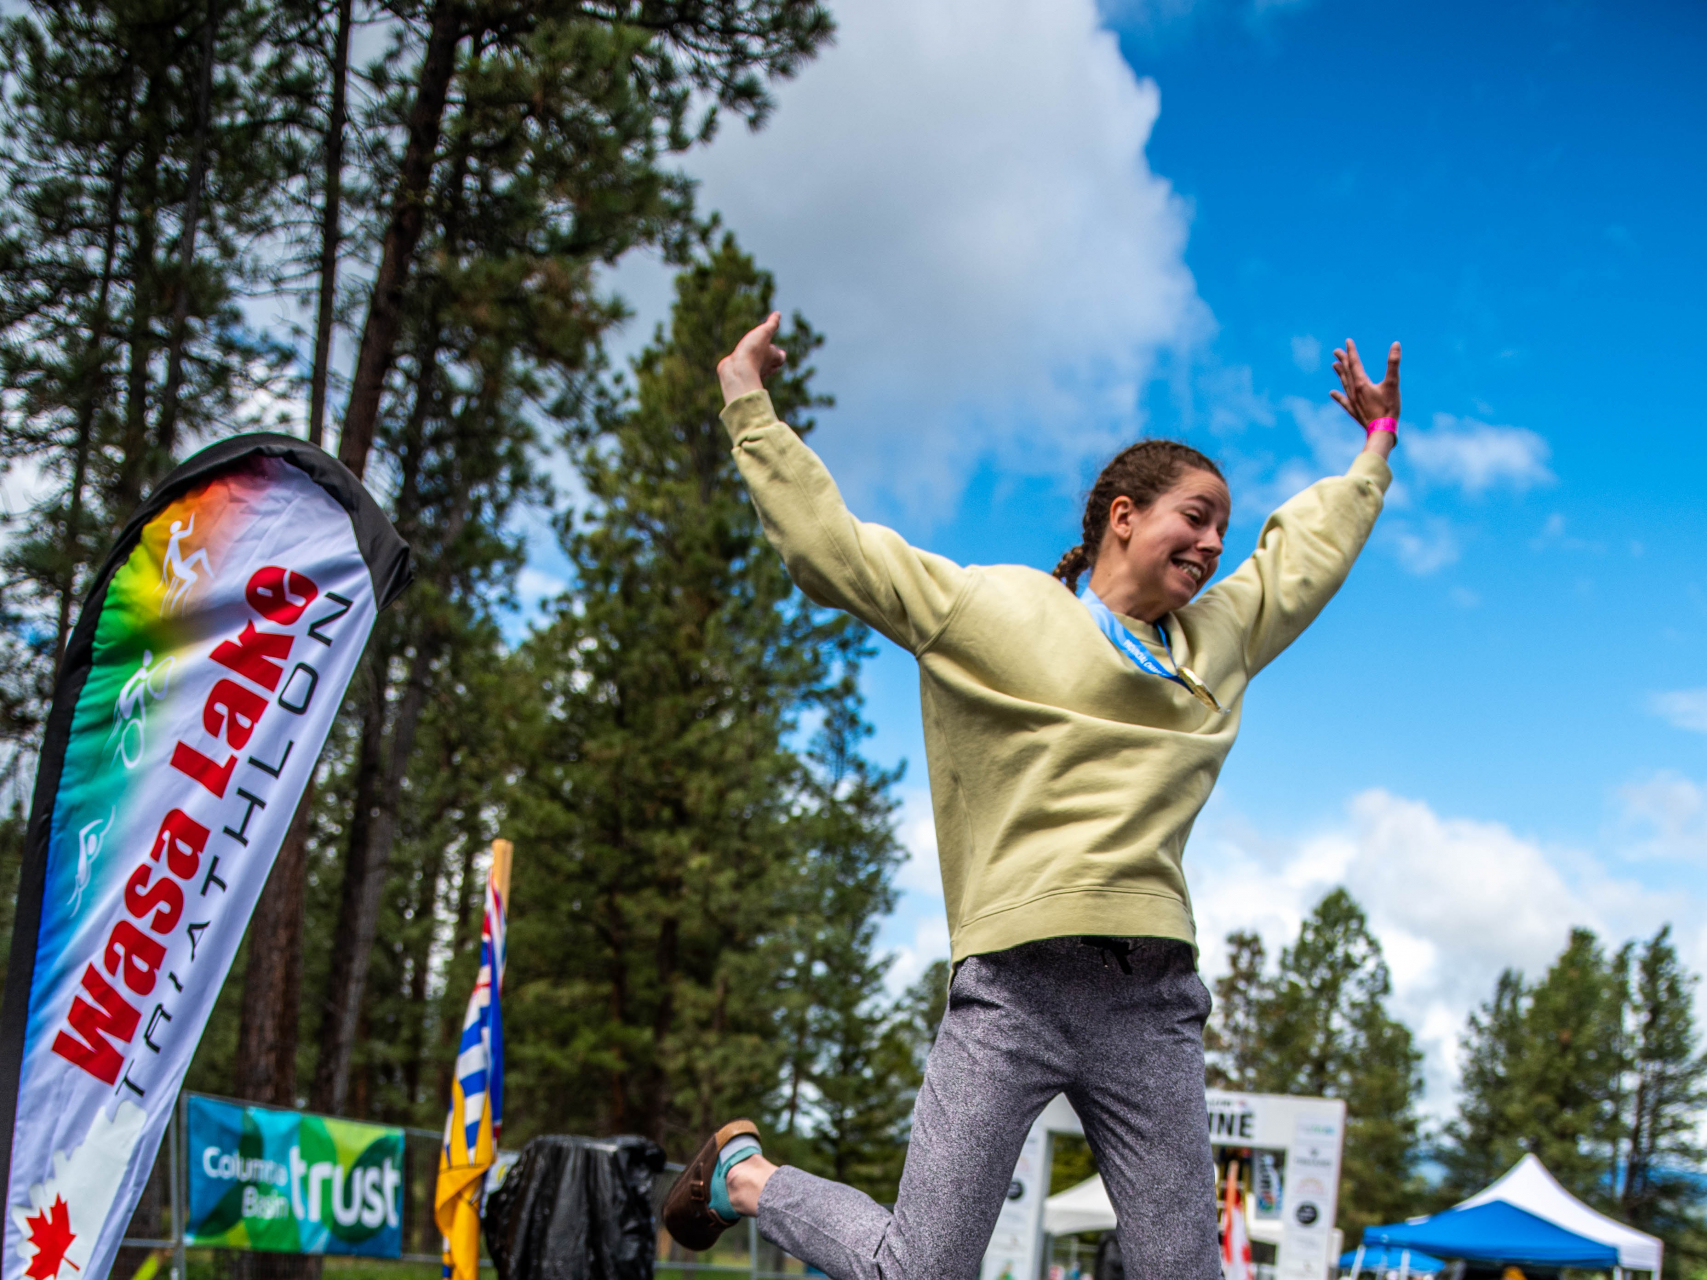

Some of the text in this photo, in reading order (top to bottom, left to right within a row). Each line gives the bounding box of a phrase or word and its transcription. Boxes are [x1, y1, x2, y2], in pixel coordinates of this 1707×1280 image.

[51, 565, 319, 1087] Wasa Lake
[114, 591, 354, 1098] TRIATHLON
[290, 1145, 400, 1229] trust
[1208, 1112, 1254, 1138] INE
